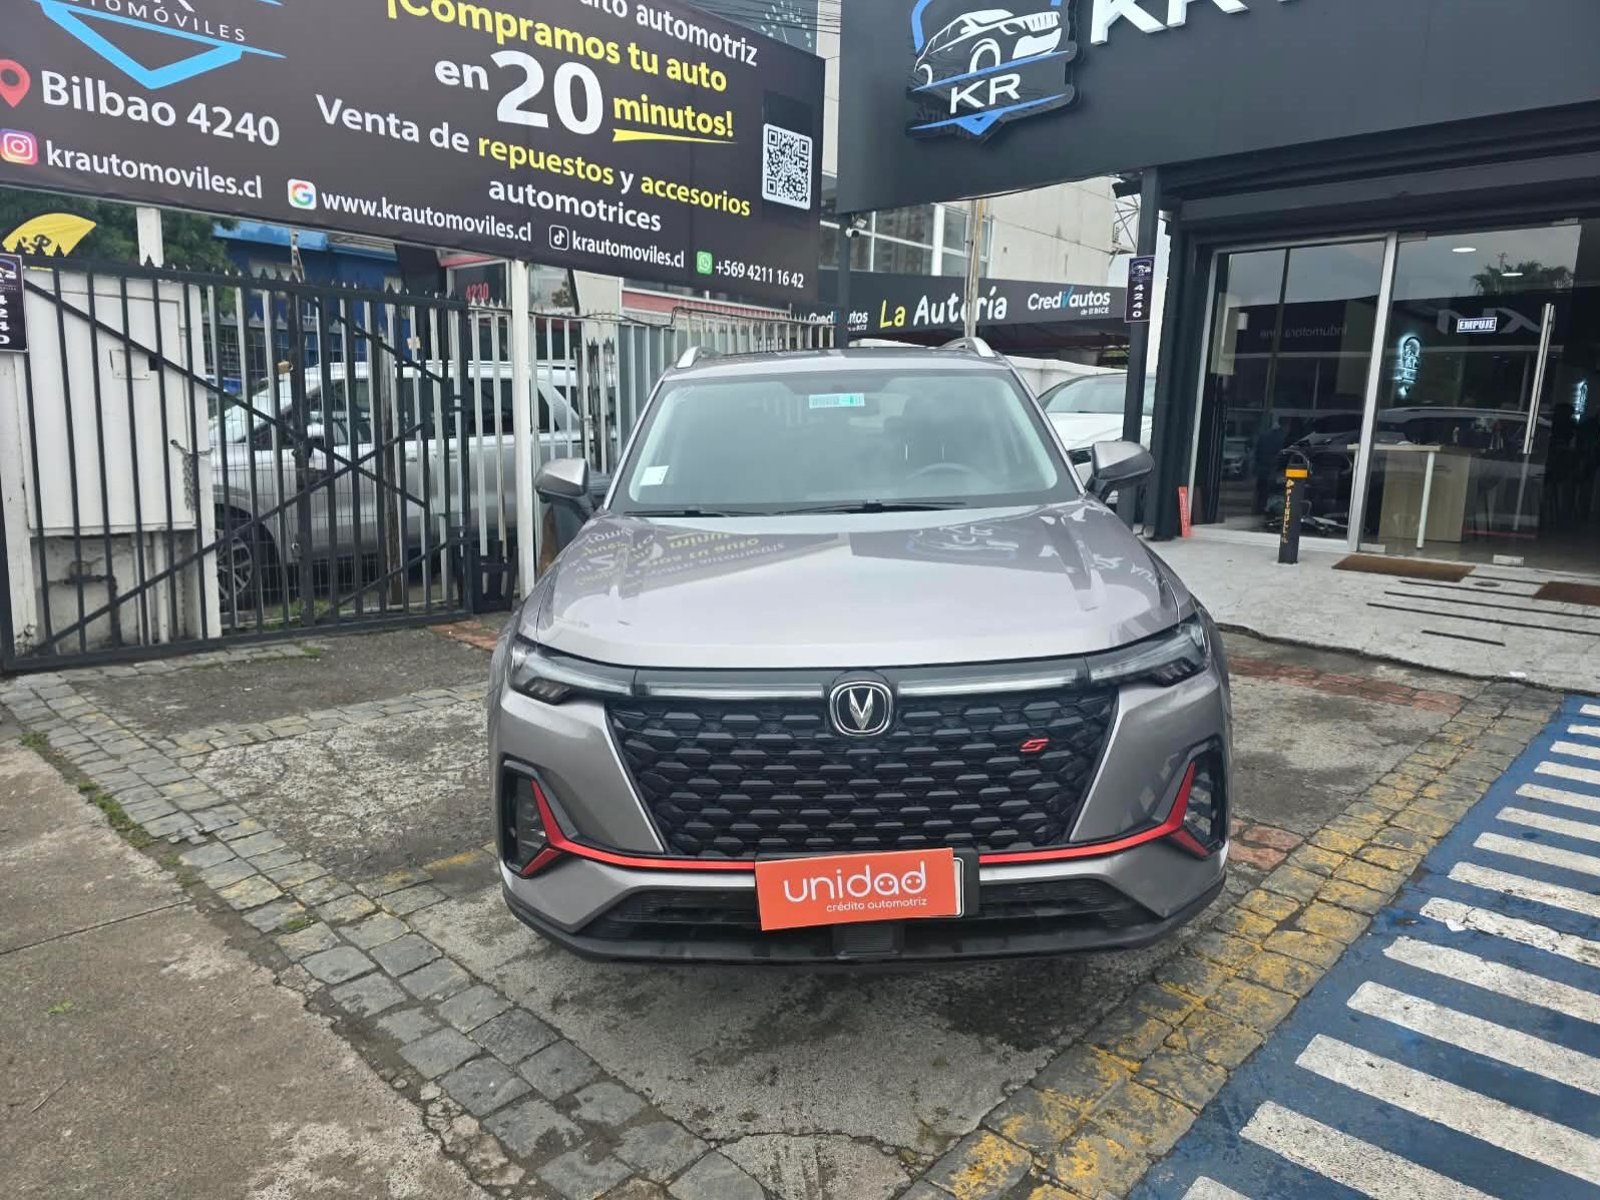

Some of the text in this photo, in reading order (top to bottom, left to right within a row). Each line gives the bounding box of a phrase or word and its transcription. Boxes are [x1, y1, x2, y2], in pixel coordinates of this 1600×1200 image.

[636, 4, 757, 67] automotriz
[628, 43, 658, 75] tu
[666, 57, 727, 92] auto
[41, 70, 280, 147] Bilbao 4240
[434, 50, 734, 138] en 20 minutos!
[949, 73, 1021, 114] KR
[46, 140, 262, 199] krautomoviles.cl
[315, 93, 751, 217] Venta de repuestos y accesorios
[321, 191, 532, 242] www.krautomoviles.cl
[489, 180, 661, 231] automotrices
[572, 231, 684, 268] krautomoviles.cl
[716, 260, 745, 278] +569
[747, 264, 773, 283] 4211
[880, 300, 906, 329] La
[1133, 284, 1144, 317] 4240
[1459, 319, 1495, 330] EMPUJE
[784, 860, 927, 902] unidad
[826, 897, 928, 913] crédito automotriz
